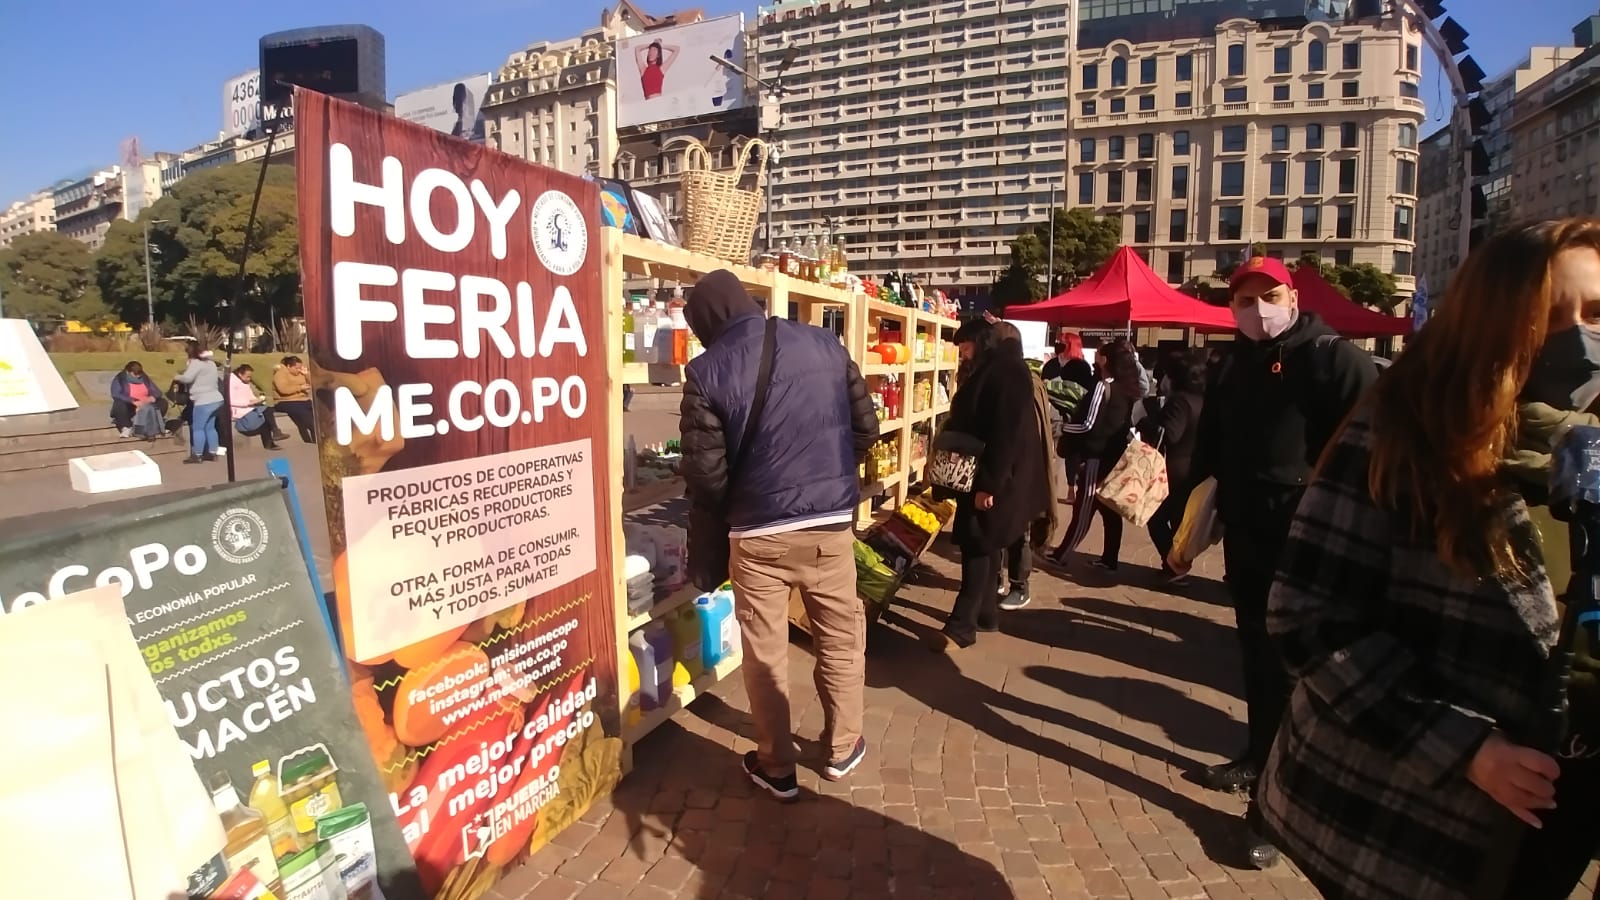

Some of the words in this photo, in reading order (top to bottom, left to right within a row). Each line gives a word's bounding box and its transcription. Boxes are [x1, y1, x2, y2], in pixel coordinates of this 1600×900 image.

[330, 142, 521, 260] HOY
[333, 261, 587, 360] FERIA
[334, 375, 586, 446] ME.CO.PO
[367, 473, 472, 504] PRODUCTOS
[476, 468, 495, 484] DE
[498, 451, 583, 479] COOPERATIVAS
[388, 491, 469, 520] FÁBRICAS
[473, 471, 565, 502] RECUPERADAS
[566, 469, 574, 481] Y
[392, 507, 480, 539] PEQUEÑOS
[484, 484, 573, 517] PRODUCTORES
[432, 534, 443, 548] Y
[446, 506, 551, 544] PRODUCTORAS.
[0, 542, 208, 614] CoPo
[135, 591, 203, 624] ECONOMÍA
[203, 573, 257, 599] POPULAR
[390, 573, 438, 597] OTRA
[443, 555, 495, 581] FORMA
[498, 547, 515, 563] DE
[408, 585, 445, 611] MÁS
[449, 574, 493, 598] JUSTA
[496, 559, 531, 580] PARA
[534, 545, 572, 567] TODAS
[432, 606, 443, 620] Y
[447, 588, 501, 615] TODOS.
[504, 564, 559, 597] ¡SUMATE!
[141, 610, 247, 662] ganizamos
[178, 633, 238, 662] todxs.
[407, 661, 488, 706] facebook:
[491, 618, 578, 669] misionmecopo
[165, 645, 300, 727] UCTOS
[429, 668, 511, 715] instagram:
[514, 639, 568, 673] me.co.po
[442, 655, 562, 726] www.mecopo.net
[181, 677, 316, 759] MACÉN
[388, 784, 428, 817] La
[438, 731, 517, 792] mejor
[523, 676, 597, 740] calidad
[401, 808, 429, 844] al
[448, 754, 525, 817] mejor
[530, 710, 594, 769] precio
[494, 765, 560, 822] PUEBLO
[495, 814, 512, 839] EN
[513, 781, 560, 826] MARCHA
